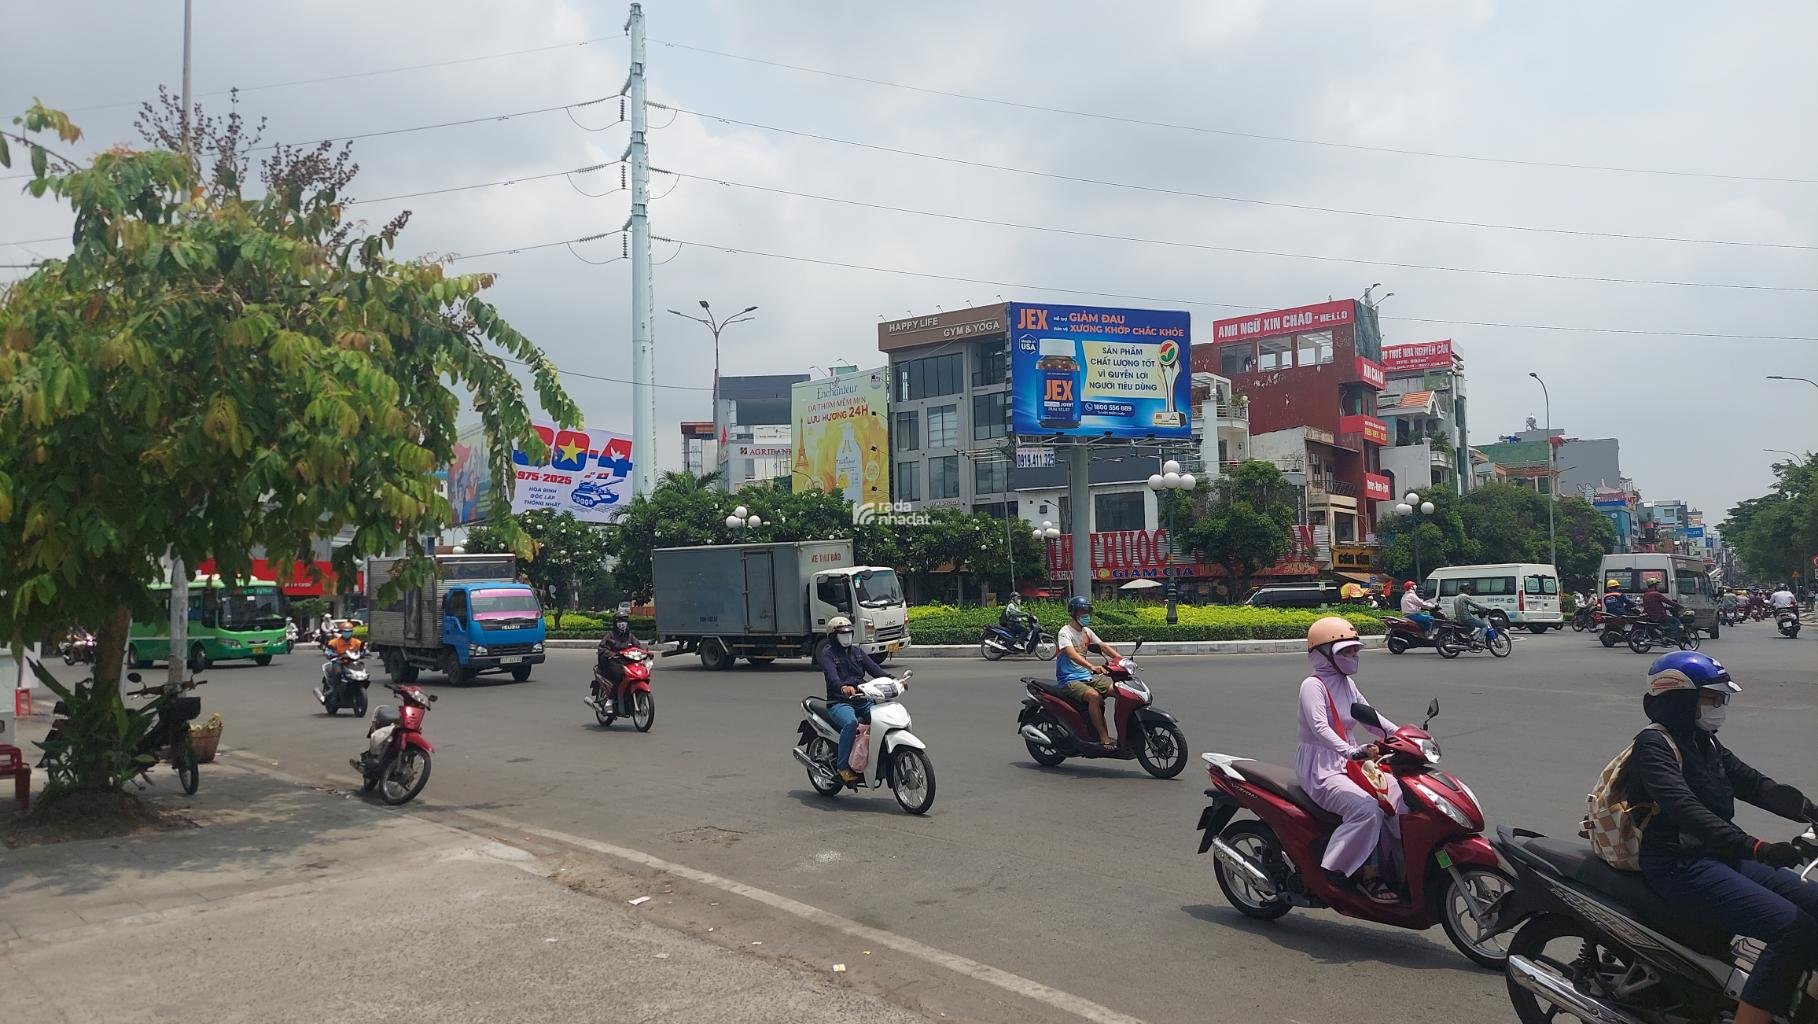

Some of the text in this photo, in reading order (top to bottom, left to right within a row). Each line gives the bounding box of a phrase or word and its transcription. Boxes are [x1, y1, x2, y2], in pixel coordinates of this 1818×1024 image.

[1017, 308, 1048, 330] JEX
[1069, 310, 1099, 322] GIẢM
[1101, 313, 1125, 324] ĐAU
[1218, 323, 1238, 338] ANH
[1263, 316, 1281, 331] XIN
[1320, 310, 1348, 322] HELLO
[889, 316, 939, 333] HAPPY LIFE
[943, 319, 1000, 337] GYM & YOGA
[1070, 323, 1103, 333] XƯƠNG
[1104, 324, 1131, 334] KHỚP
[1021, 343, 1036, 351] USA
[1102, 345, 1143, 355] SẢN PHẨM
[1090, 356, 1111, 366] CHẤT
[1142, 358, 1156, 367] TỐT
[1097, 369, 1106, 378] VÌ
[1044, 379, 1073, 401] JEX
[1117, 382, 1133, 391] TIÊU
[1135, 381, 1158, 391] DÙNG
[848, 404, 869, 418] 24H
[515, 471, 573, 485] 975-2025
